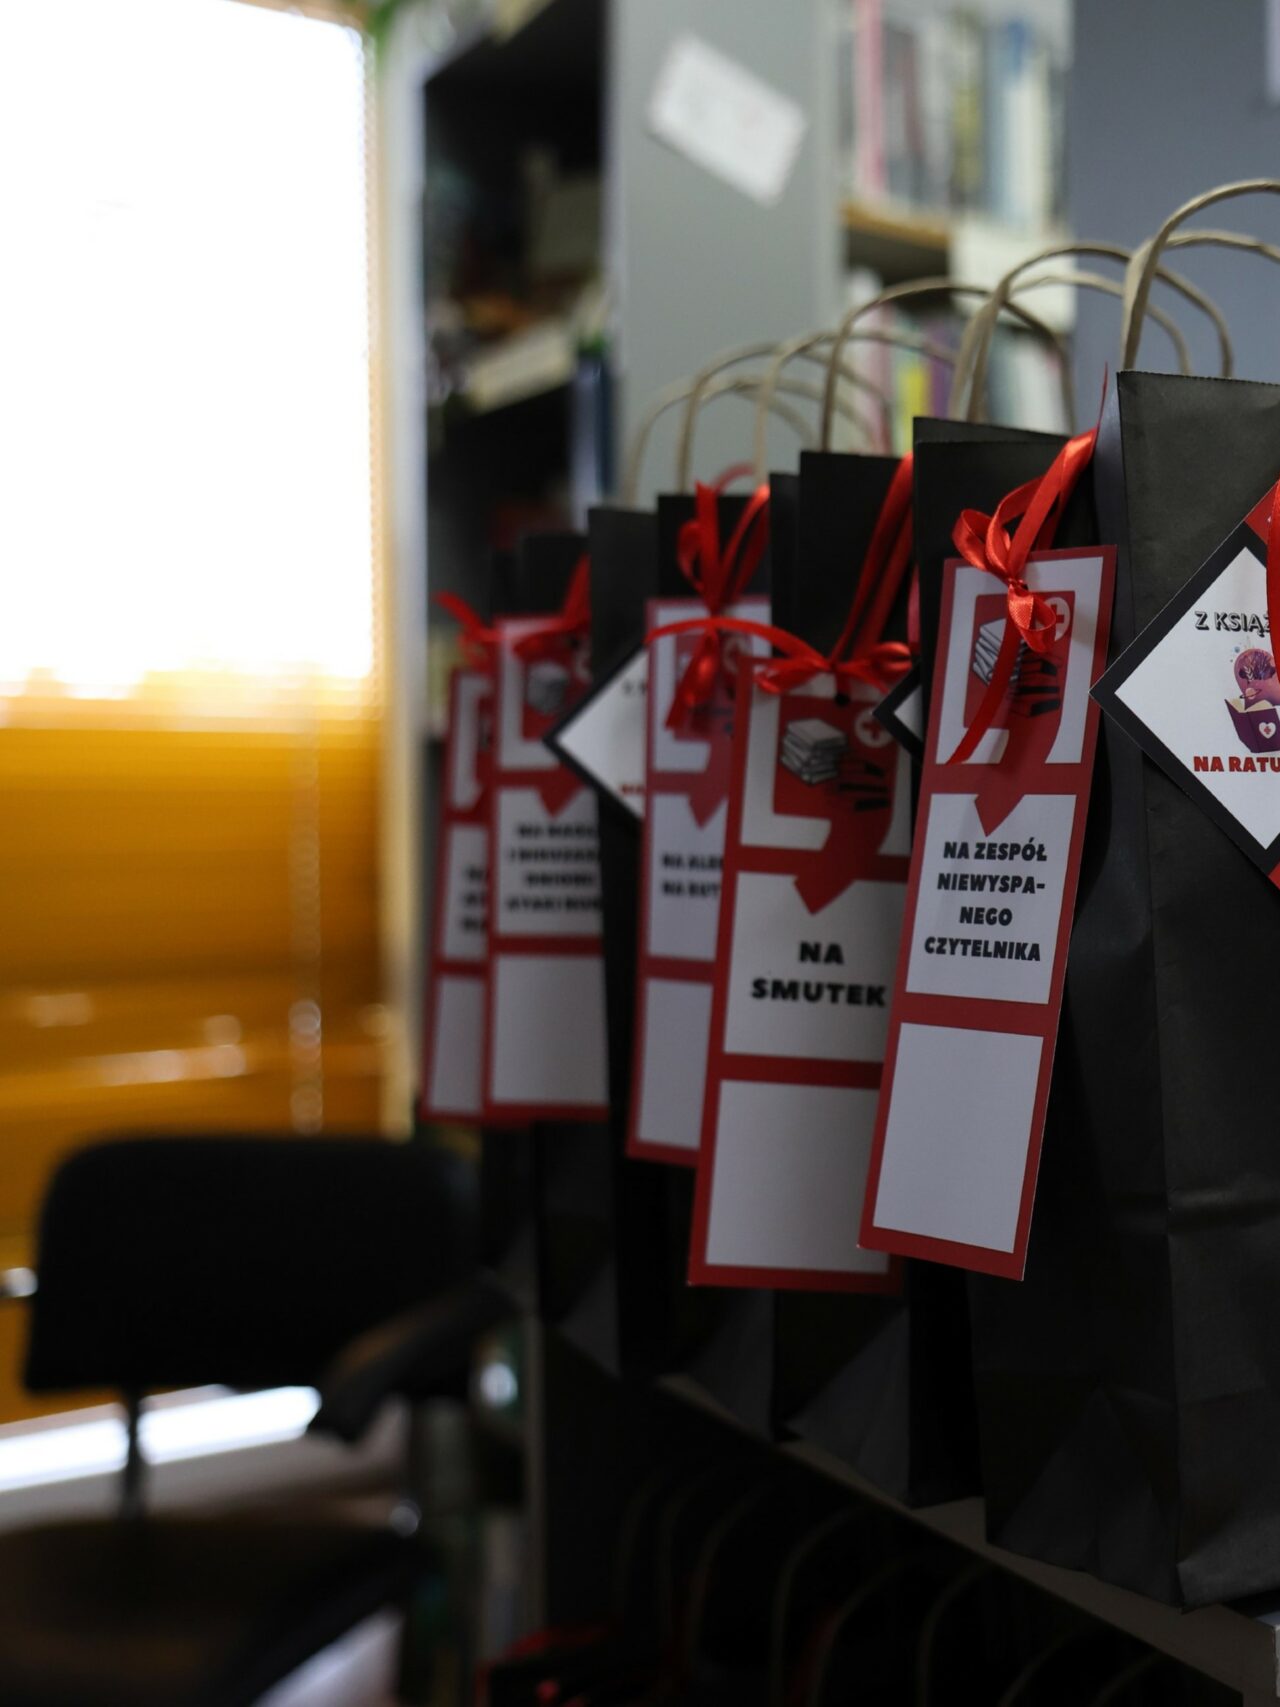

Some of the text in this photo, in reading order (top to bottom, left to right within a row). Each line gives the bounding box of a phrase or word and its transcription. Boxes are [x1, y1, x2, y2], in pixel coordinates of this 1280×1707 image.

[1194, 610, 1210, 631] Z
[1193, 756, 1228, 773] NA
[943, 836, 1048, 861] NA ZESPÓŁ
[937, 873, 1046, 894] NIEWYSPA-
[959, 906, 1013, 926] NEGO
[799, 941, 844, 965] NA
[924, 936, 1041, 961] CZYTELNIKA
[752, 978, 887, 1008] SMUTEK
